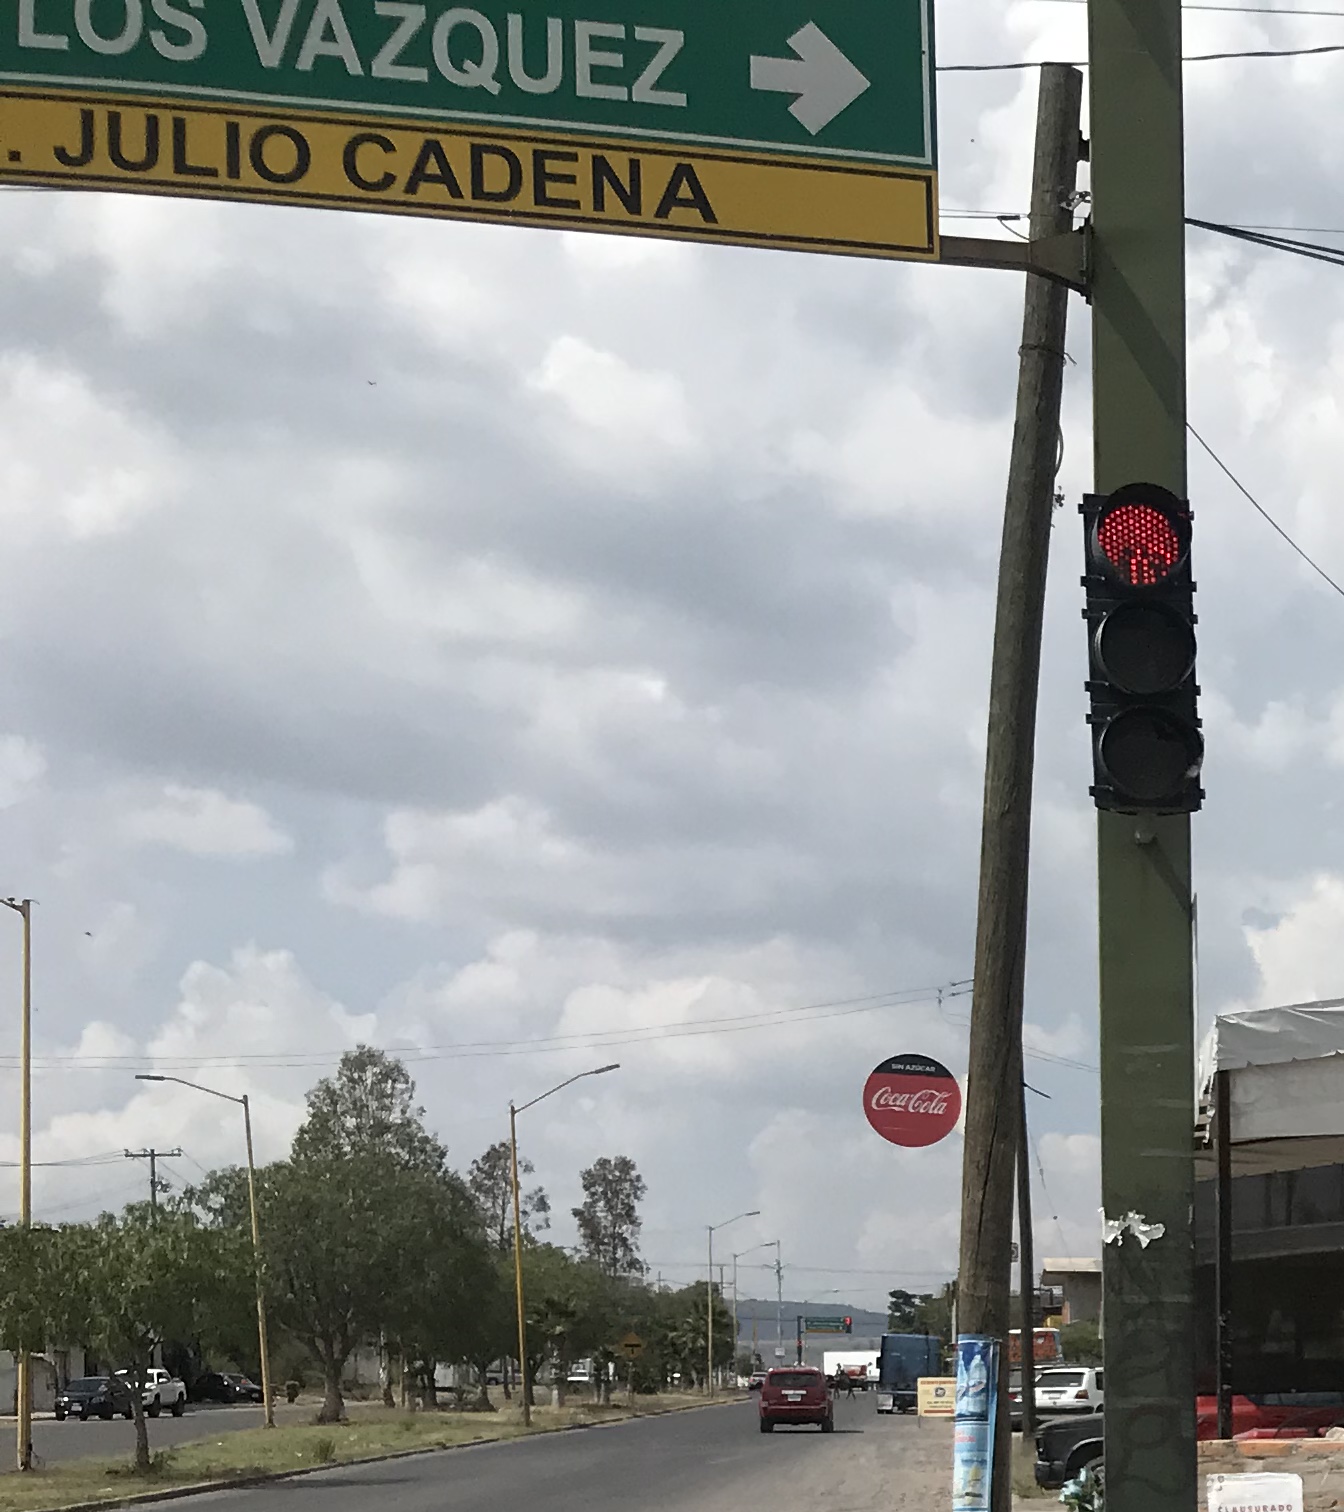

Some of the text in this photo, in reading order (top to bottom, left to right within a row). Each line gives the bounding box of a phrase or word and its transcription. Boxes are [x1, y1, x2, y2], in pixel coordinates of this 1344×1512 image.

[18, 0, 688, 108] LOS VAZQUEZ
[53, 107, 719, 225] JULIO CADENA
[871, 1086, 953, 1115] Coca-Cola
